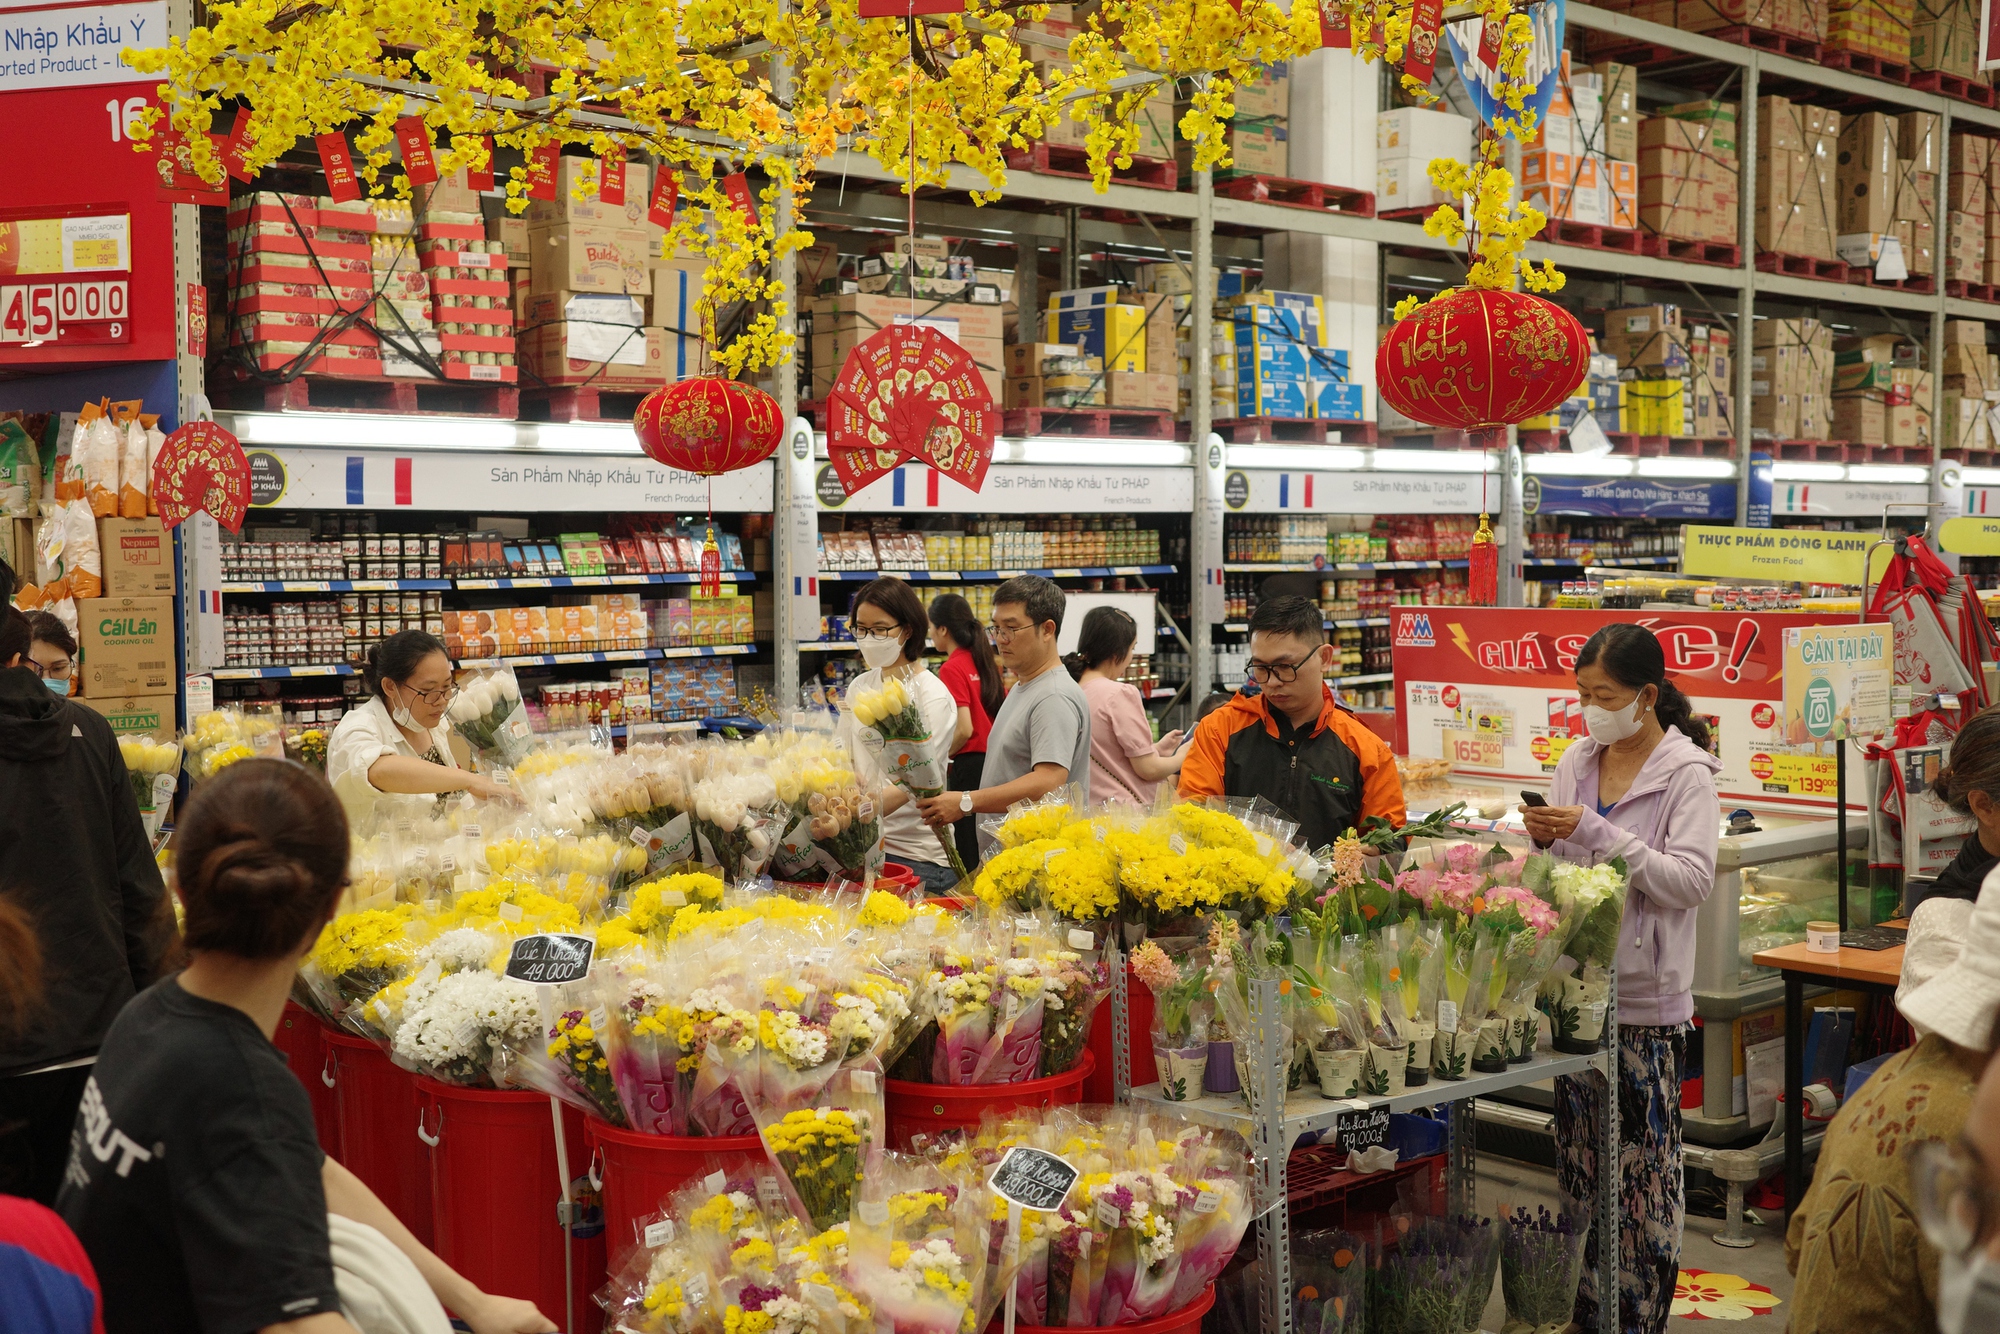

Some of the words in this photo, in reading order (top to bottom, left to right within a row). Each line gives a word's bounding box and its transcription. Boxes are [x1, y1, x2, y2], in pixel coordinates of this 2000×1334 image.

[5, 26, 58, 56] Nhập
[66, 16, 121, 47] Khẩu
[130, 13, 145, 42] Ý
[41, 54, 97, 74] Product
[106, 97, 150, 142] 16
[586, 248, 620, 264] Buldak
[490, 468, 518, 483] Sản
[523, 465, 563, 484] Phẩm
[568, 469, 601, 487] Nhập
[607, 466, 641, 484] Khẩu
[646, 469, 664, 484] Từ
[994, 476, 1014, 489] Sản
[1017, 474, 1046, 489] Phẩm
[1049, 477, 1074, 492] Nhập
[1077, 474, 1102, 490] Khẩu
[1122, 476, 1150, 489] PHÁP
[644, 494, 673, 503] French
[675, 494, 710, 503] Products
[1983, 524, 2000, 533] HO
[122, 540, 157, 548] Neptune
[1698, 534, 1732, 548] THỰC
[1735, 532, 1775, 548] PHẨM
[1779, 536, 1821, 550] ĐÔNG
[1827, 539, 1866, 553] LẠNH
[1752, 555, 1781, 564] Frozen
[1783, 557, 1804, 565] Food
[104, 638, 139, 646] COOKING
[1477, 632, 1548, 670] GIÁ
[1801, 632, 1834, 665] CÂN
[1837, 636, 1857, 668] TẠI
[1860, 630, 1883, 659] ĐÂY
